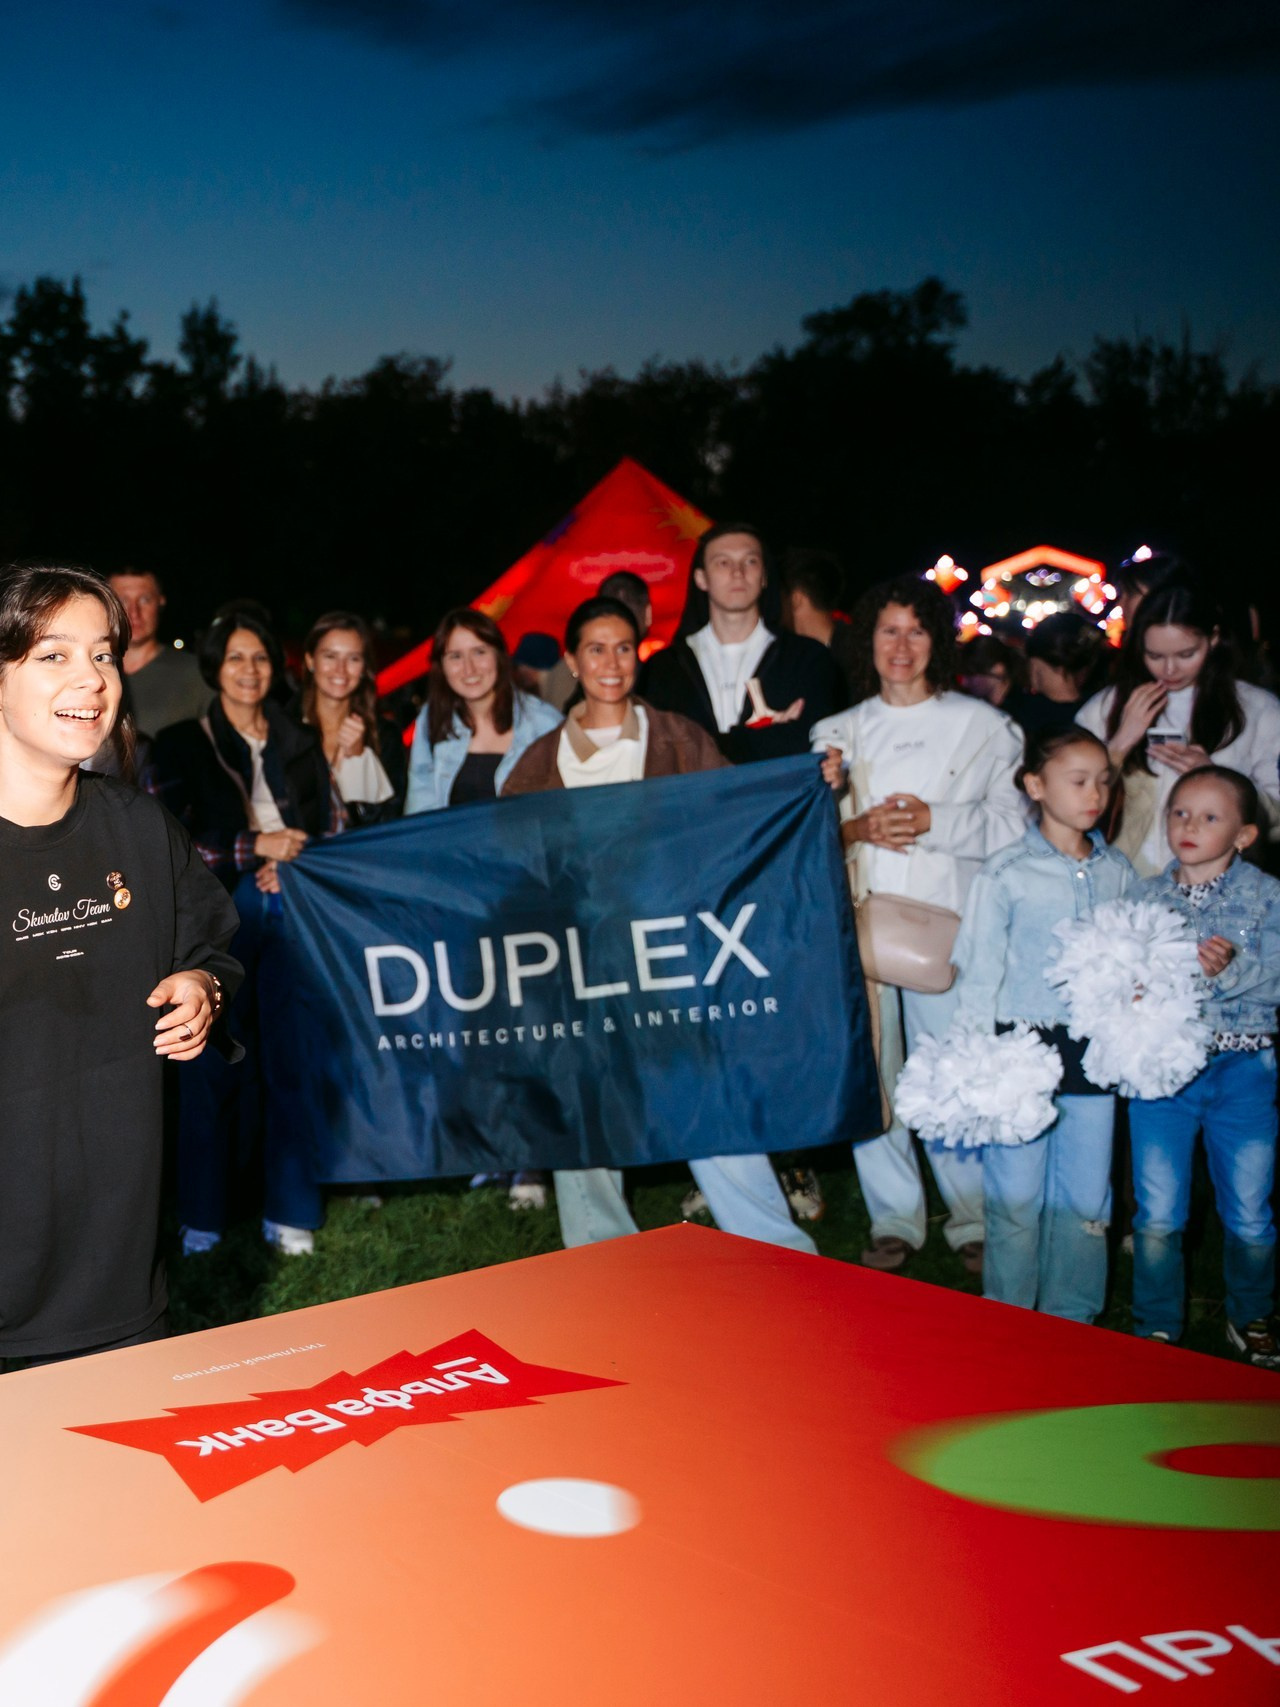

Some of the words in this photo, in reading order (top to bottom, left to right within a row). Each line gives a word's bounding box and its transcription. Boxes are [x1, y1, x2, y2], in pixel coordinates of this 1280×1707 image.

[12, 907, 70, 932] Skuratov
[72, 898, 111, 920] Team
[364, 902, 771, 1017] DUPLEX
[377, 1020, 585, 1051] ARCHITECTURE
[602, 1017, 617, 1032] &
[634, 997, 780, 1028] INTERIOR
[171, 1361, 241, 1382] партнер
[242, 1342, 326, 1366] титульный
[325, 1357, 510, 1416] Альфа
[174, 1409, 347, 1456] Банк
